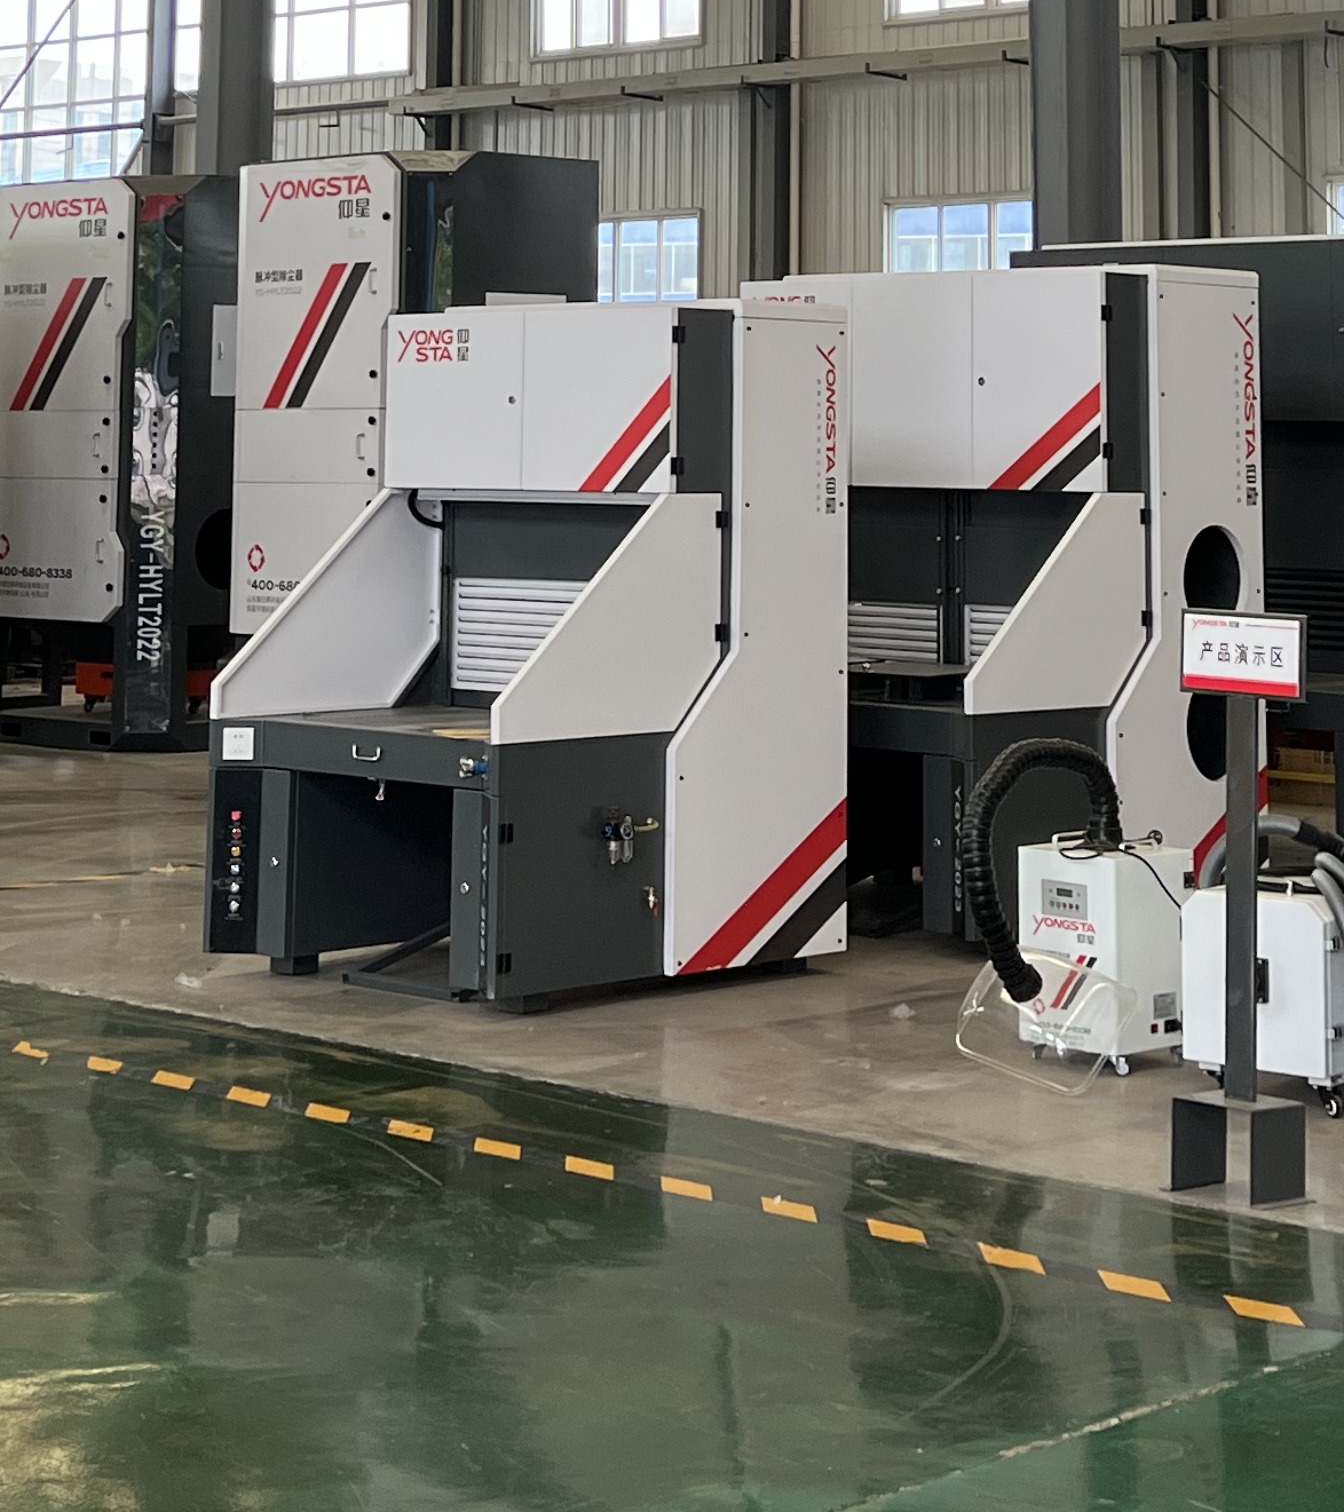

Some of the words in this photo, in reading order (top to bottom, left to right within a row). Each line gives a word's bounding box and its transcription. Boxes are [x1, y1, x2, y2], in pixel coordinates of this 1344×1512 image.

[259, 175, 372, 223] YONGSTA
[338, 198, 370, 220] 仰星
[9, 197, 108, 240] YONGSTA
[79, 218, 107, 238] 仰星
[397, 329, 454, 363] YONG
[416, 346, 453, 362] STA
[1232, 312, 1256, 460] YONGSTA
[815, 344, 837, 475] YONGSTA
[137, 511, 165, 661] YGY-HYLT2022
[1200, 640, 1284, 668] 产品演示区
[1032, 915, 1097, 936] YONGSTA
